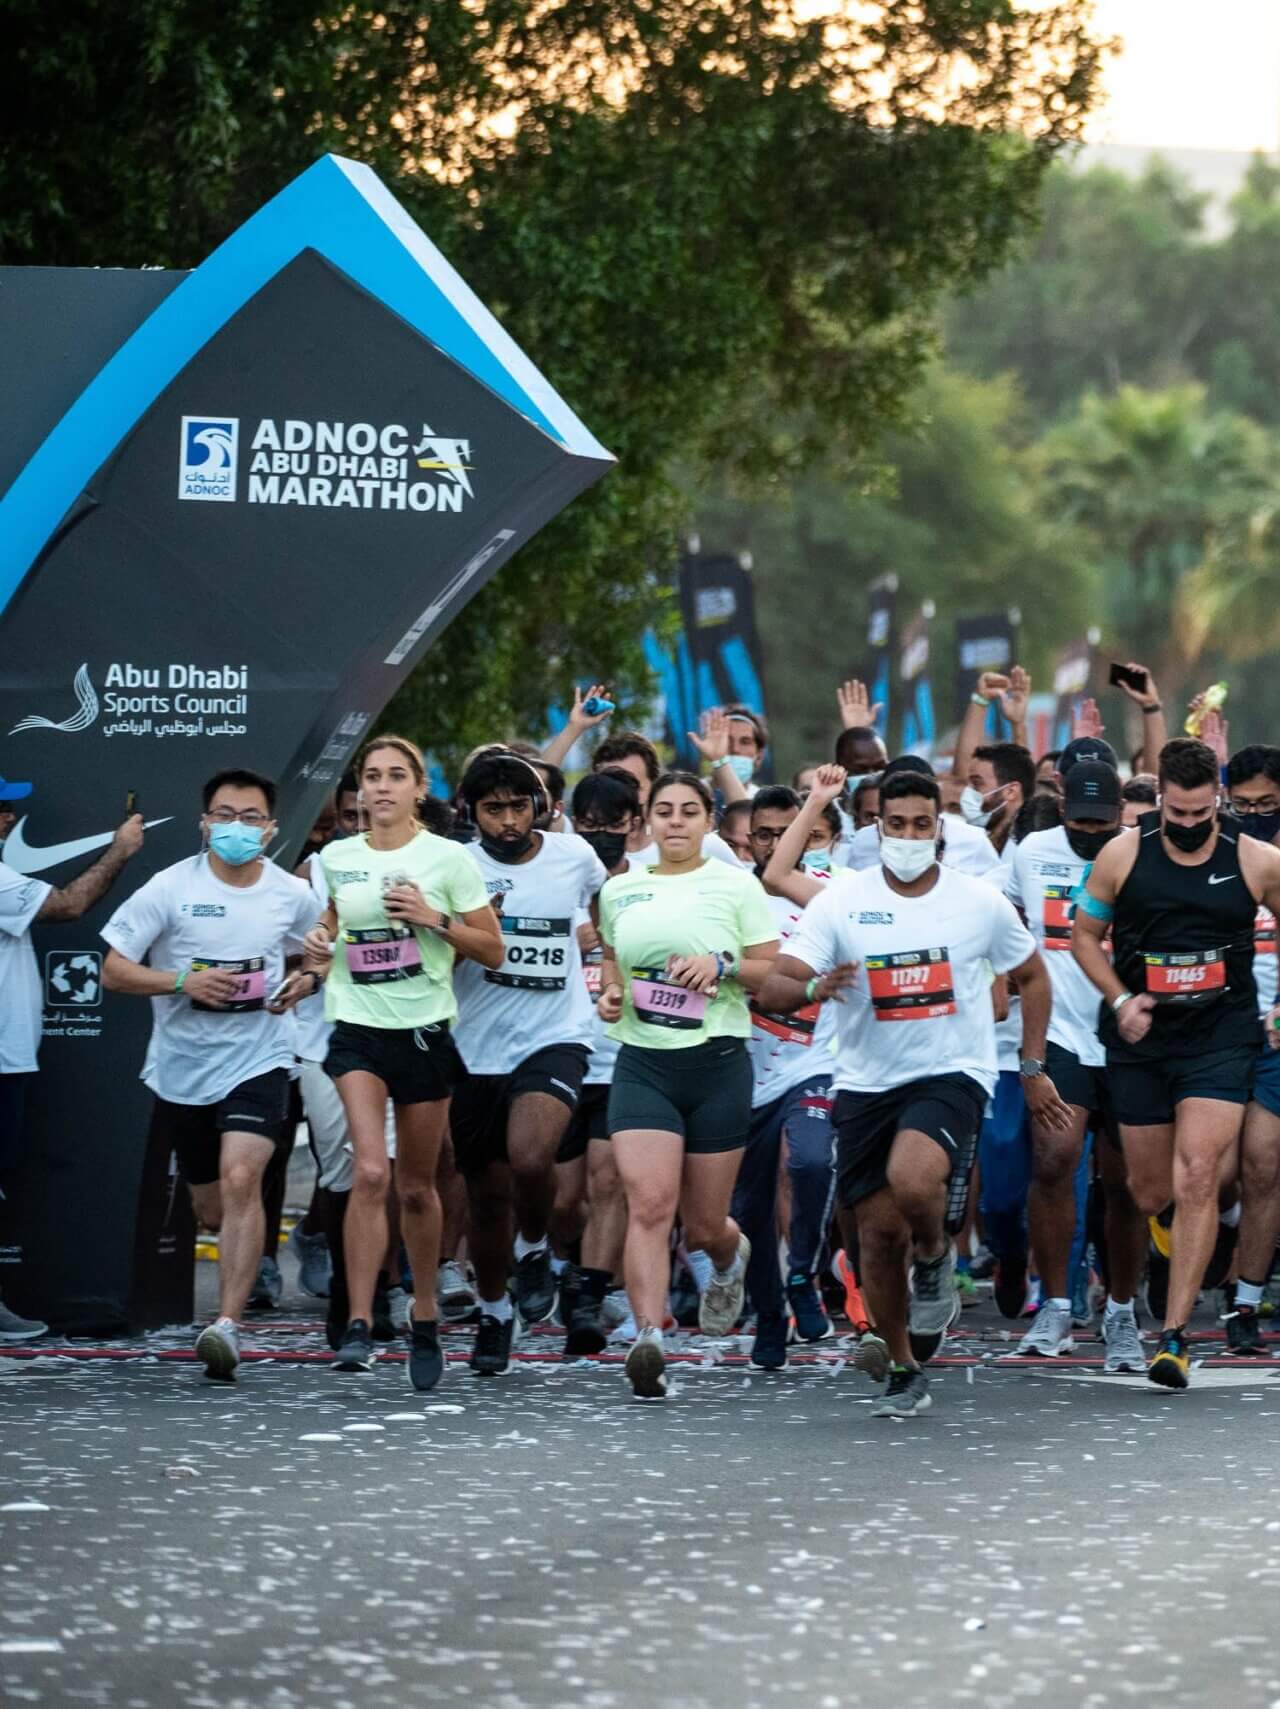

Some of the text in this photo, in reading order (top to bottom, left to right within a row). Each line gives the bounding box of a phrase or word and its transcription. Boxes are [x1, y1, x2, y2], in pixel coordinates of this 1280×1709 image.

[250, 419, 409, 456] ADNOC
[250, 451, 408, 480] ABU DHABI
[185, 484, 230, 496] ADNOC
[248, 475, 463, 512] MARATHON
[104, 664, 248, 689] Abu Dhabi
[104, 693, 248, 716] Sports Council
[103, 719, 151, 737] الرياضي
[206, 720, 247, 737] مجلس
[505, 946, 565, 966] 0218
[648, 989, 688, 1009] 13319
